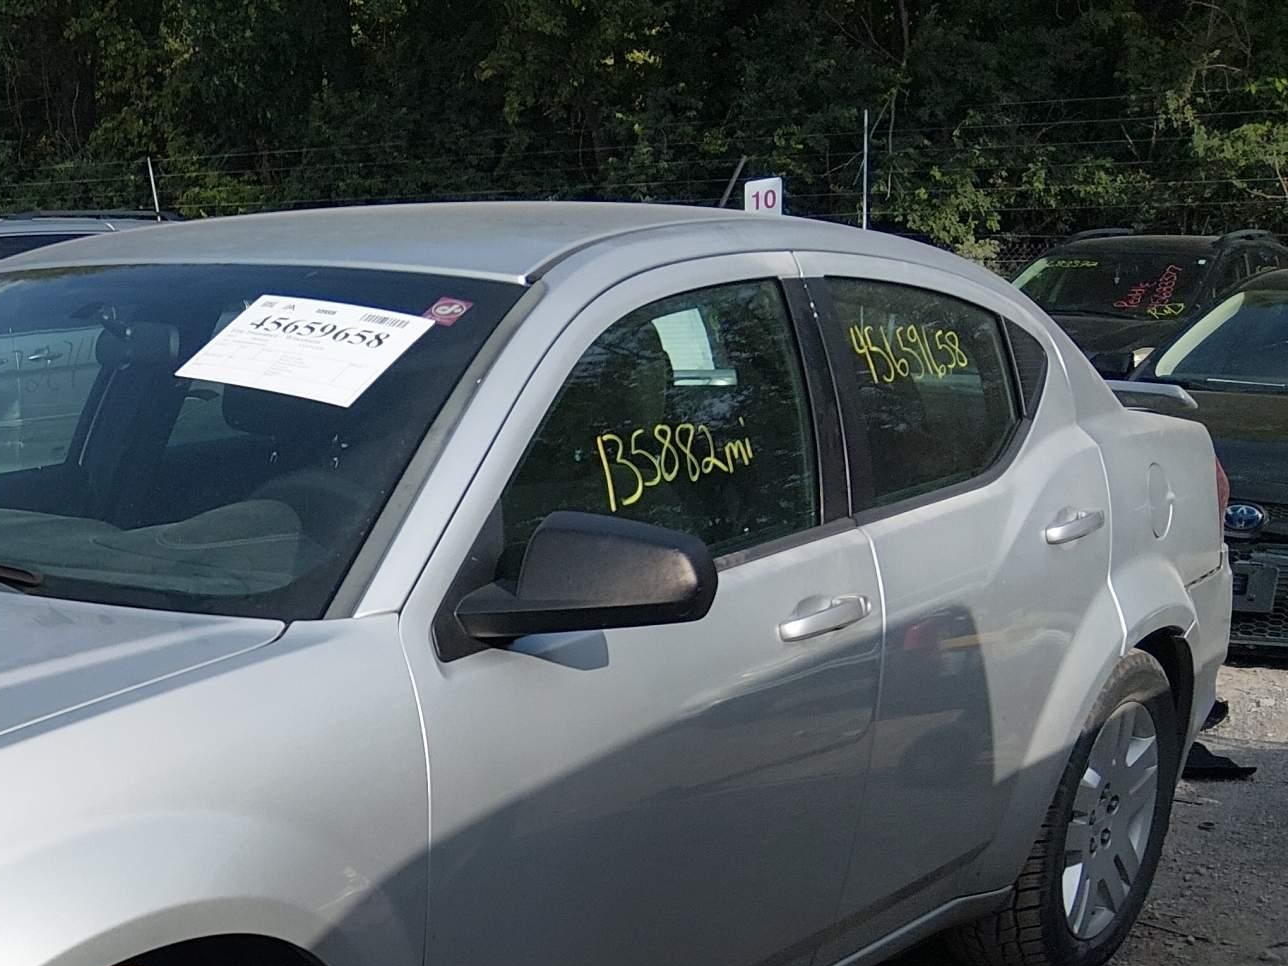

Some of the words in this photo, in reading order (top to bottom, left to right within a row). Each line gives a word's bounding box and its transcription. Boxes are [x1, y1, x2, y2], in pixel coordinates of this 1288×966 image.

[752, 189, 776, 210] 10
[250, 314, 391, 349] 45659658
[850, 324, 968, 384] 45659658
